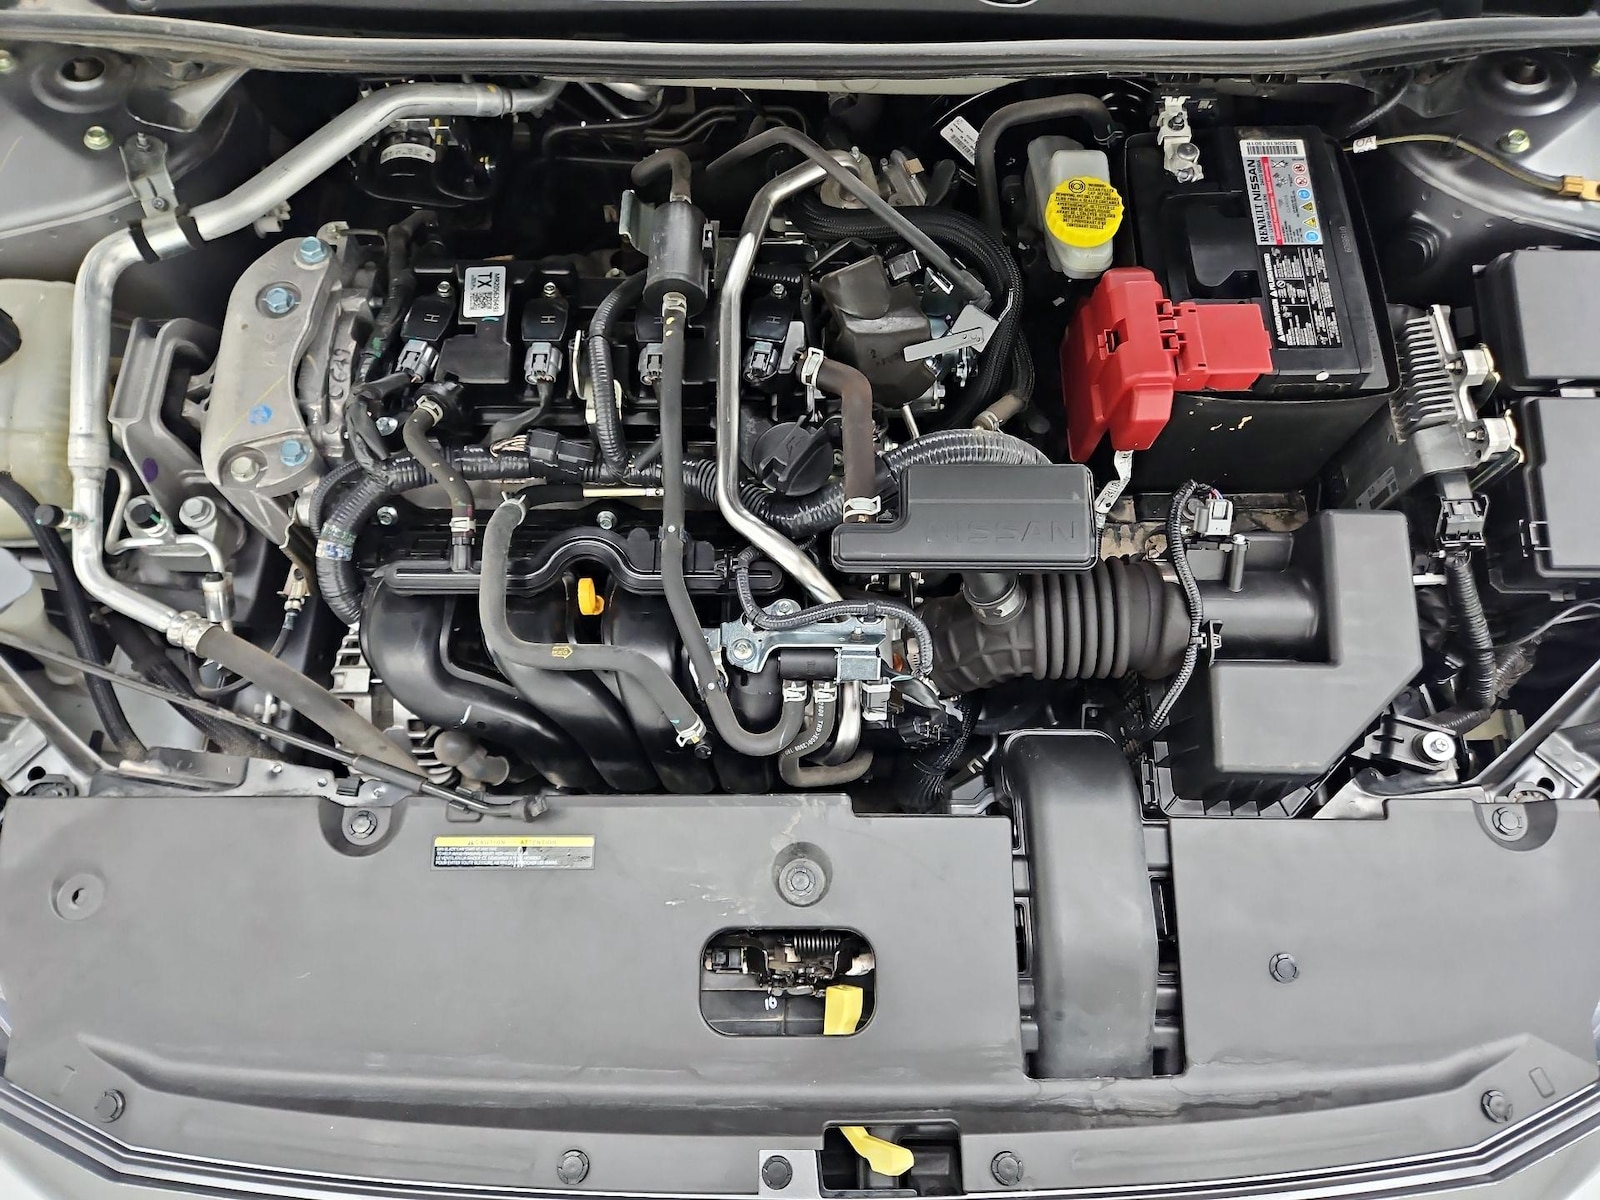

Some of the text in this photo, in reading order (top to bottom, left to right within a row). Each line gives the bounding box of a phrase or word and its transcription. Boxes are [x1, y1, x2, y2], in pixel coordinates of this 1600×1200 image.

[1246, 160, 1262, 201] NISSAN
[1254, 204, 1269, 242] RENAULT
[478, 272, 492, 288] TX
[540, 315, 556, 324] H
[766, 316, 781, 324] H
[926, 520, 1079, 543] NISSAN
